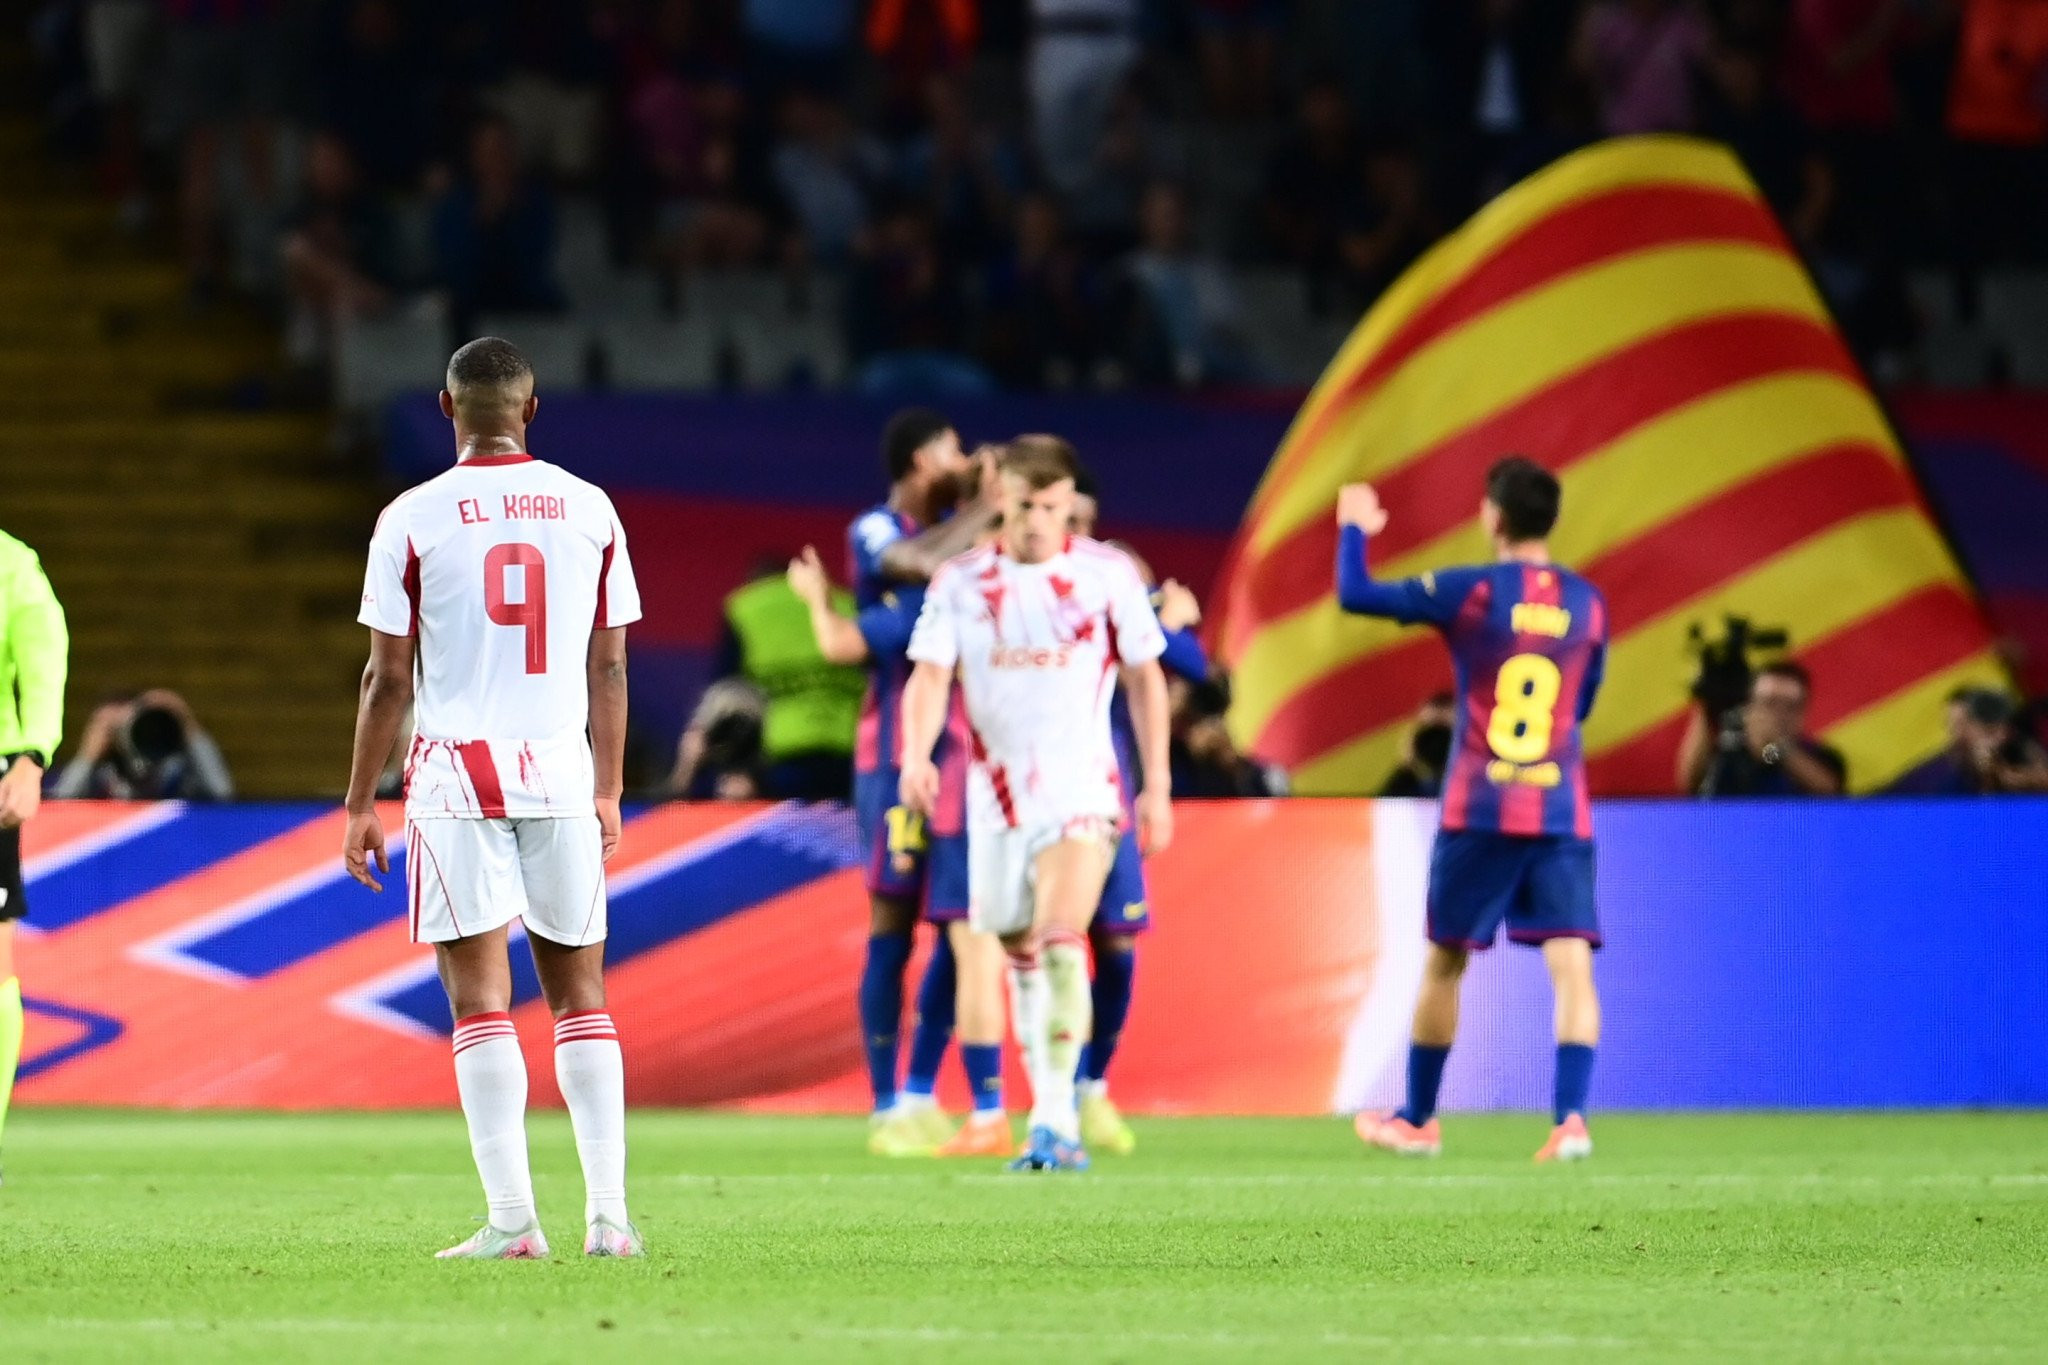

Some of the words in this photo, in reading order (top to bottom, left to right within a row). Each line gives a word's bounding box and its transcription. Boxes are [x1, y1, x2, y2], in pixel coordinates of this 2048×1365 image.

[458, 498, 489, 525] EL
[503, 494, 566, 521] KAABI
[484, 543, 547, 675] 9
[1486, 652, 1561, 764] 8
